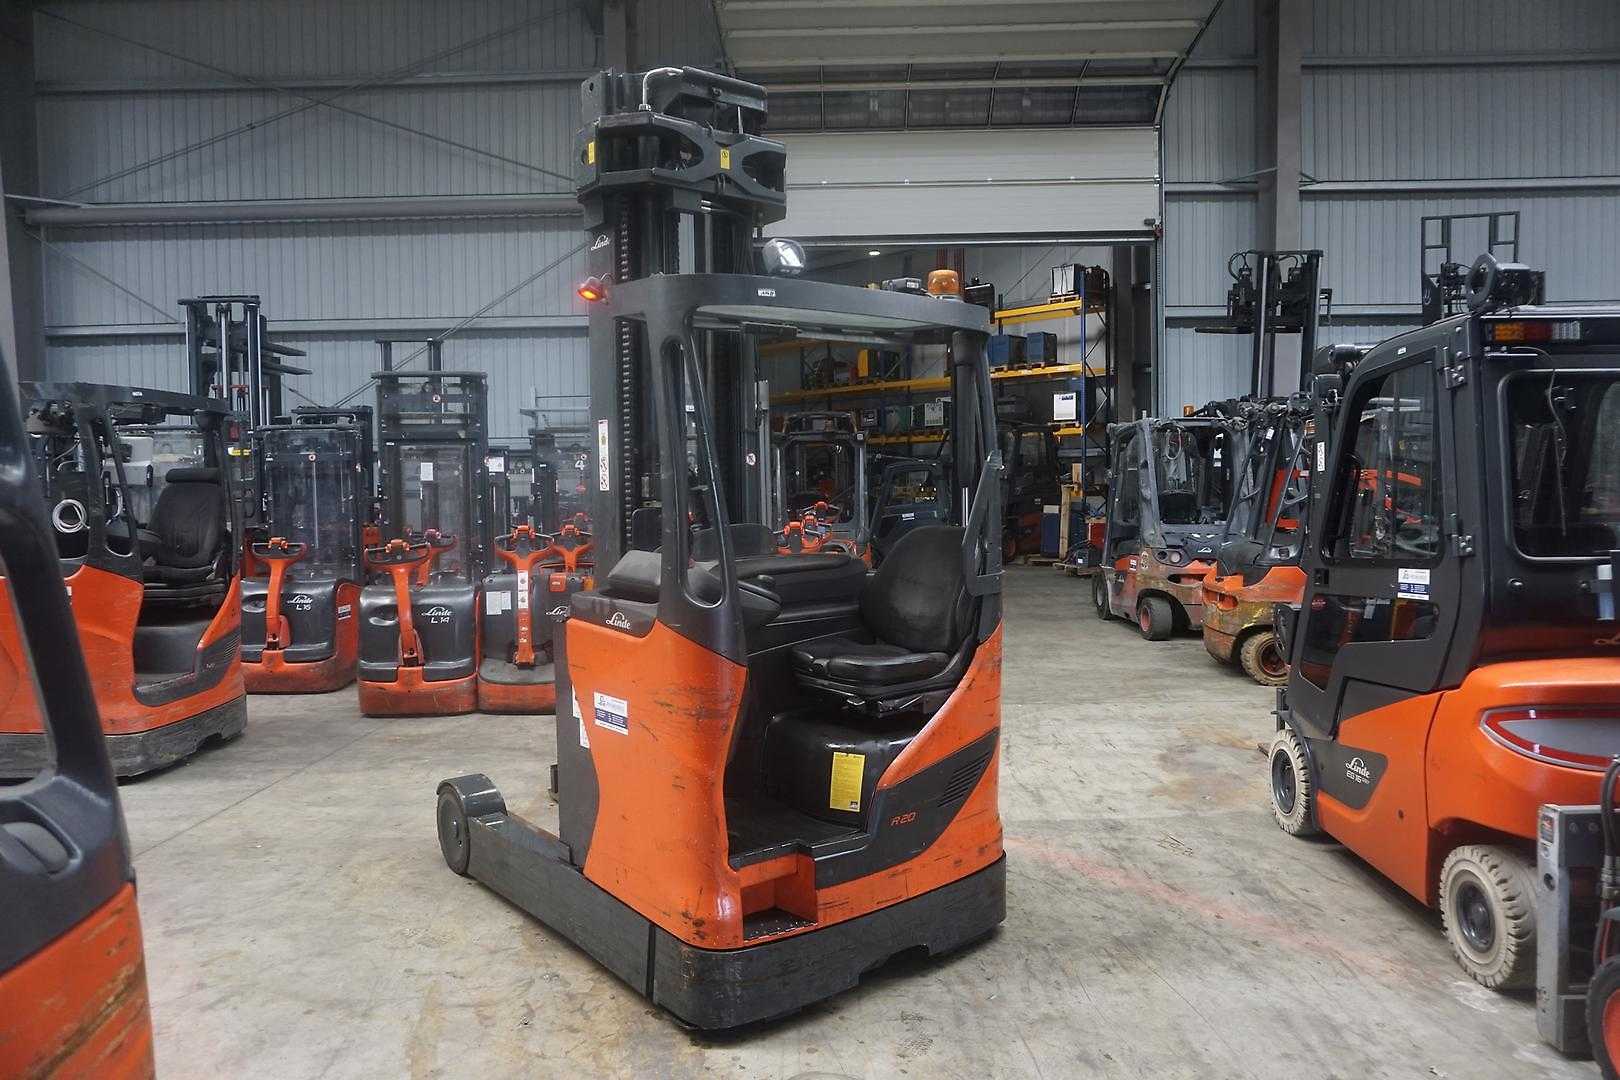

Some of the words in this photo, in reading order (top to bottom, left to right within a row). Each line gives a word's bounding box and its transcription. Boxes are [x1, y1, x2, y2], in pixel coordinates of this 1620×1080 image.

[287, 594, 313, 604] Linde
[421, 606, 453, 616] Linde
[605, 611, 631, 630] Linde
[1345, 757, 1370, 779] Linde
[890, 811, 917, 827] R20
